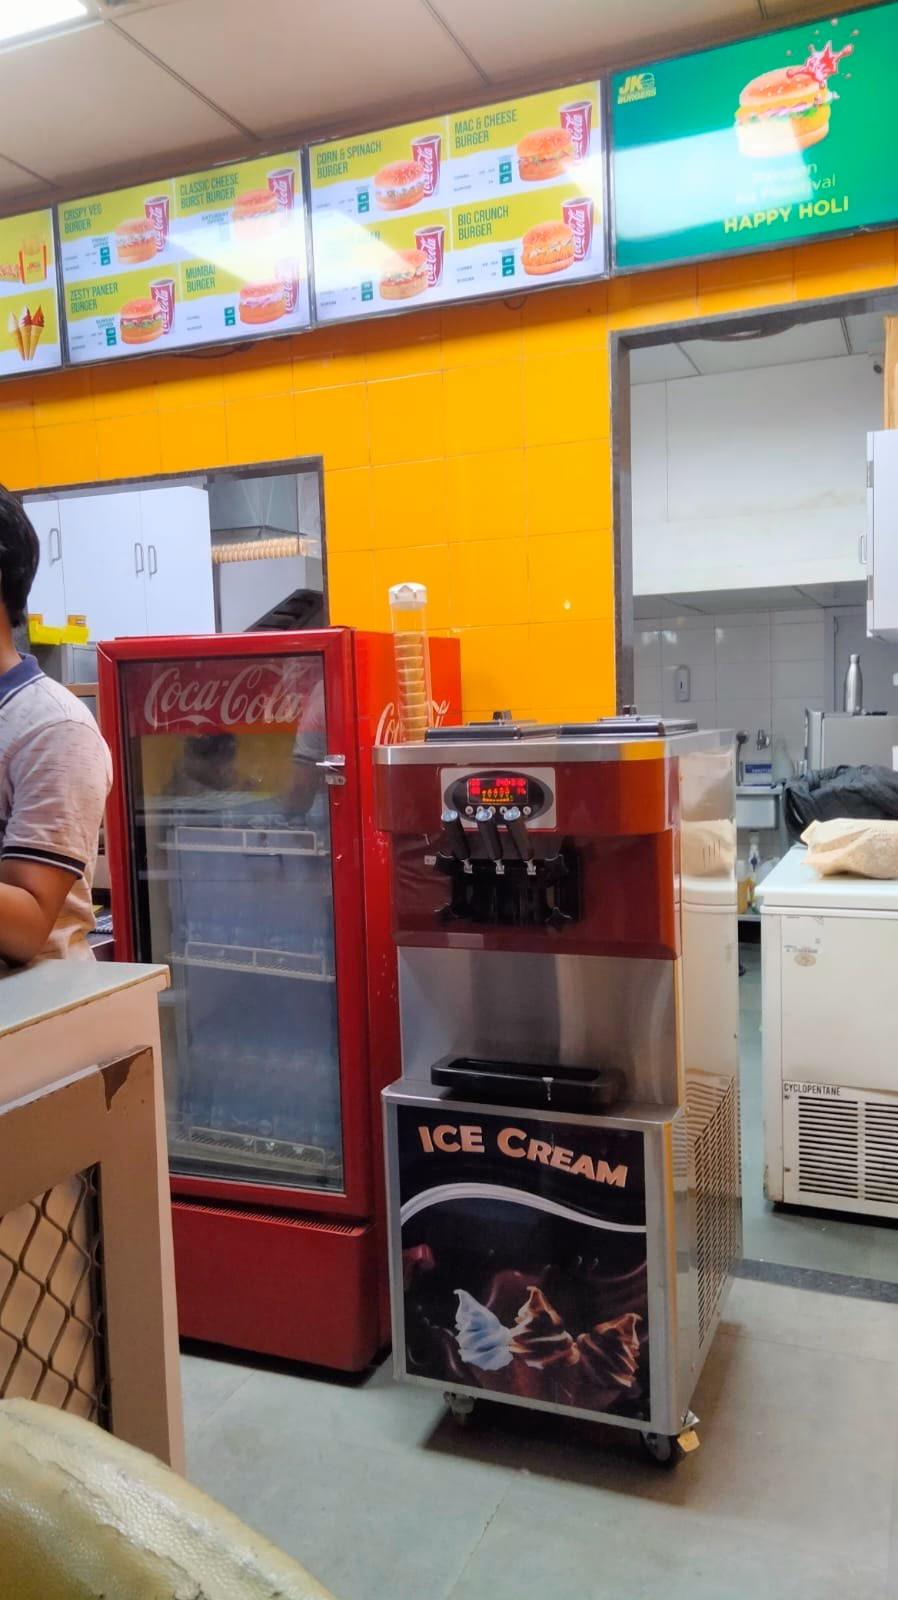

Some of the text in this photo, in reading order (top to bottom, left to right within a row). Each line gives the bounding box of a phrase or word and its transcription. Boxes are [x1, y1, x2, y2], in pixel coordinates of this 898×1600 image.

[619, 74, 643, 94] JK
[455, 109, 518, 135] MAC & CHEESE
[455, 130, 489, 148] BURGER
[316, 140, 382, 166] CORN & SPINACH
[317, 162, 348, 179] BURGER
[180, 173, 239, 196] CLASSIC CHEESE
[181, 187, 235, 208] BURST BURGER
[64, 203, 102, 221] CRISPY VEG
[457, 206, 509, 226] BIG CRUNCH
[724, 195, 848, 233] HAPPY HOLI
[64, 219, 91, 234] BURGER
[458, 223, 492, 240] BURGER
[186, 264, 216, 279] MUMBAI
[70, 282, 118, 302] ZESTY PANEER
[187, 277, 216, 292] BURGER
[71, 299, 97, 313] BURGER
[144, 662, 311, 728] Coca-Cola
[784, 1083, 841, 1097] CYCLOPENTANE
[418, 1125, 485, 1153] ICE
